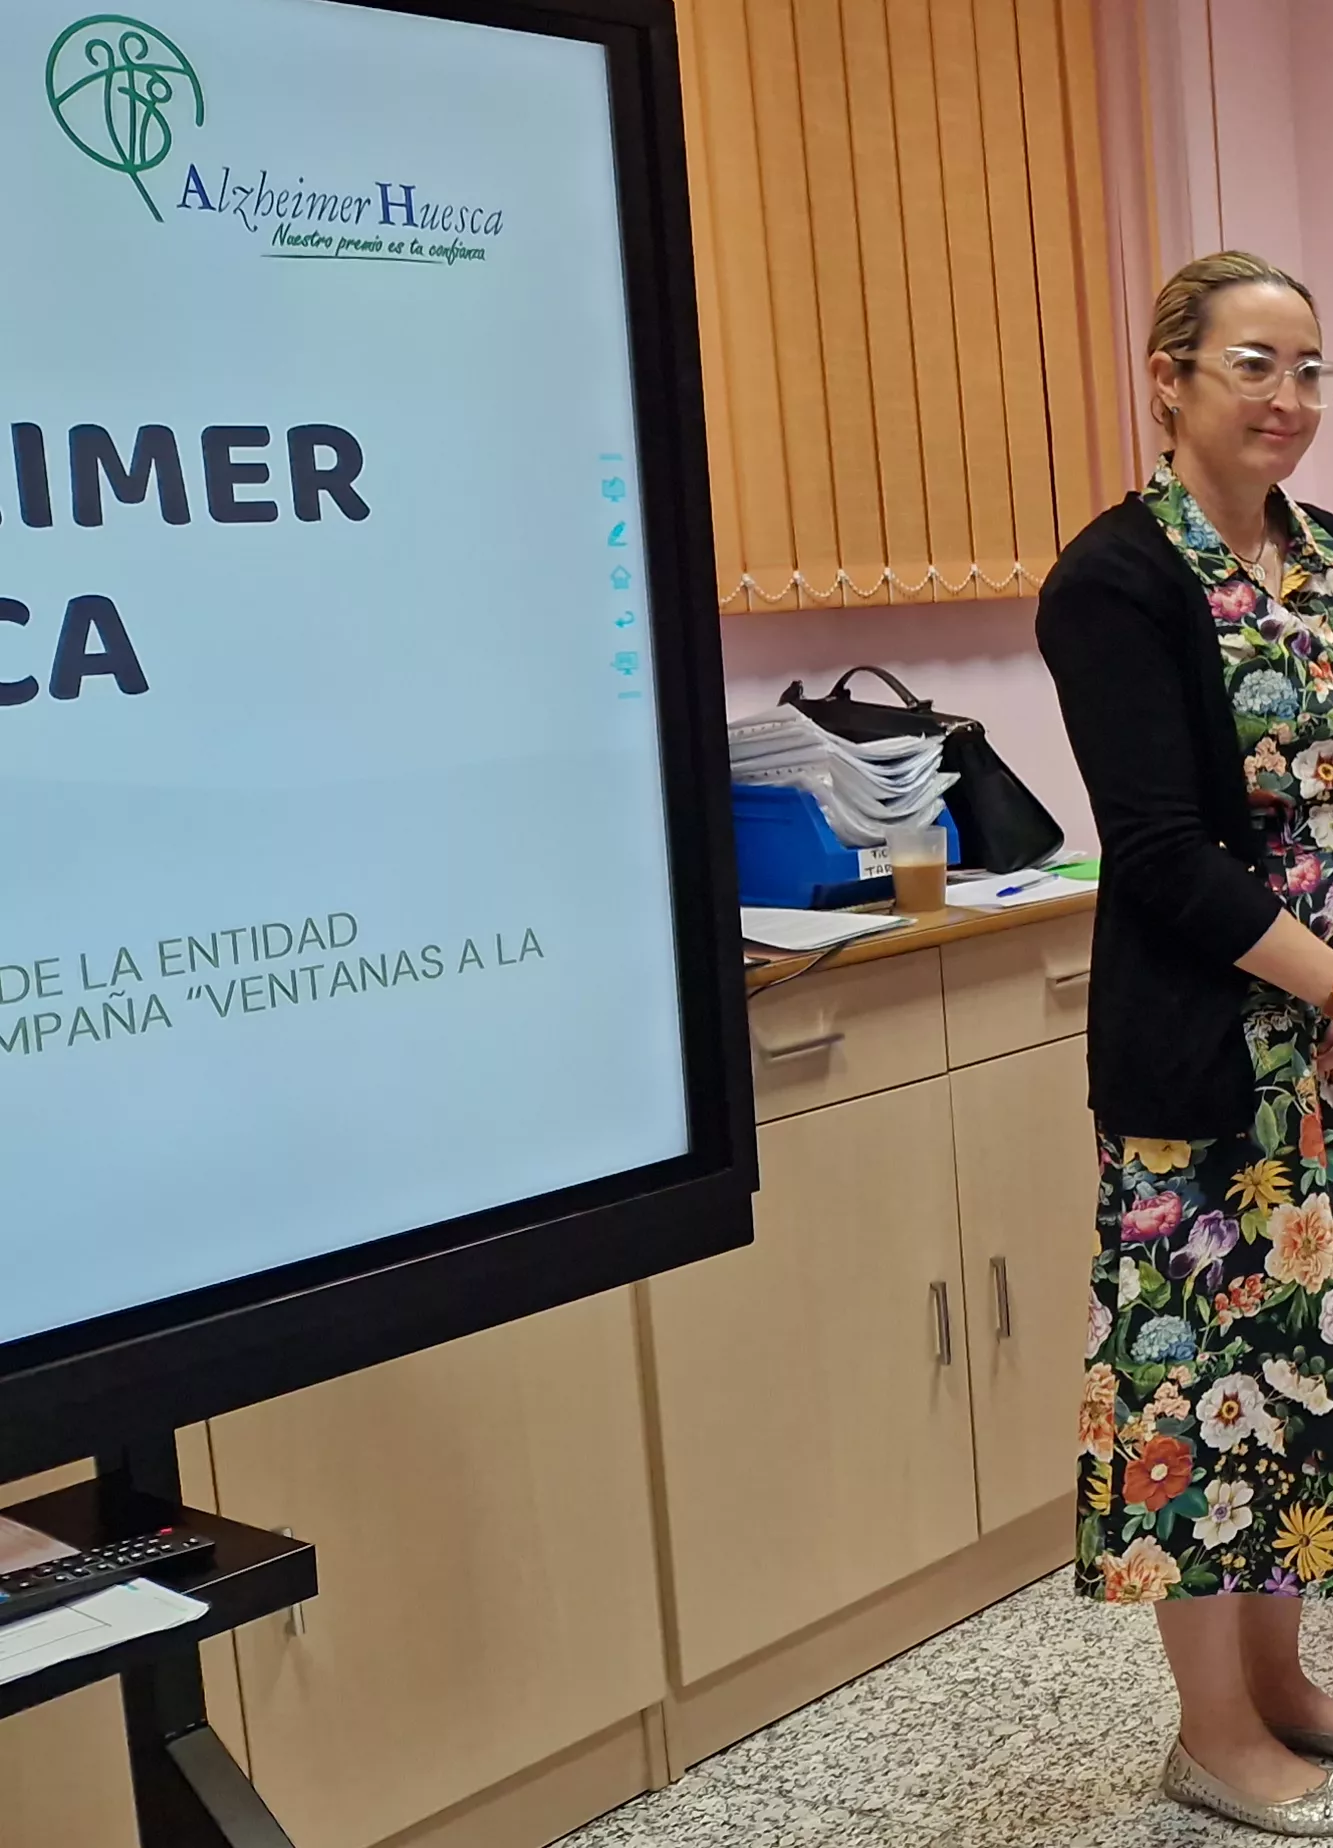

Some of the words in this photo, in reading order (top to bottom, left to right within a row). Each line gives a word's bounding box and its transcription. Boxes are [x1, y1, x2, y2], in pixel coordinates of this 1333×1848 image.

[176, 163, 371, 232] Alzheimer
[375, 181, 503, 236] Huesca
[335, 234, 383, 257] premio
[388, 241, 405, 255] es
[429, 237, 486, 266] confianza
[0, 422, 371, 528] IMER
[0, 957, 63, 1005] DE
[80, 946, 143, 991] LA
[158, 912, 359, 978] ENTIDAD
[457, 938, 485, 974] A
[496, 927, 545, 966] LA
